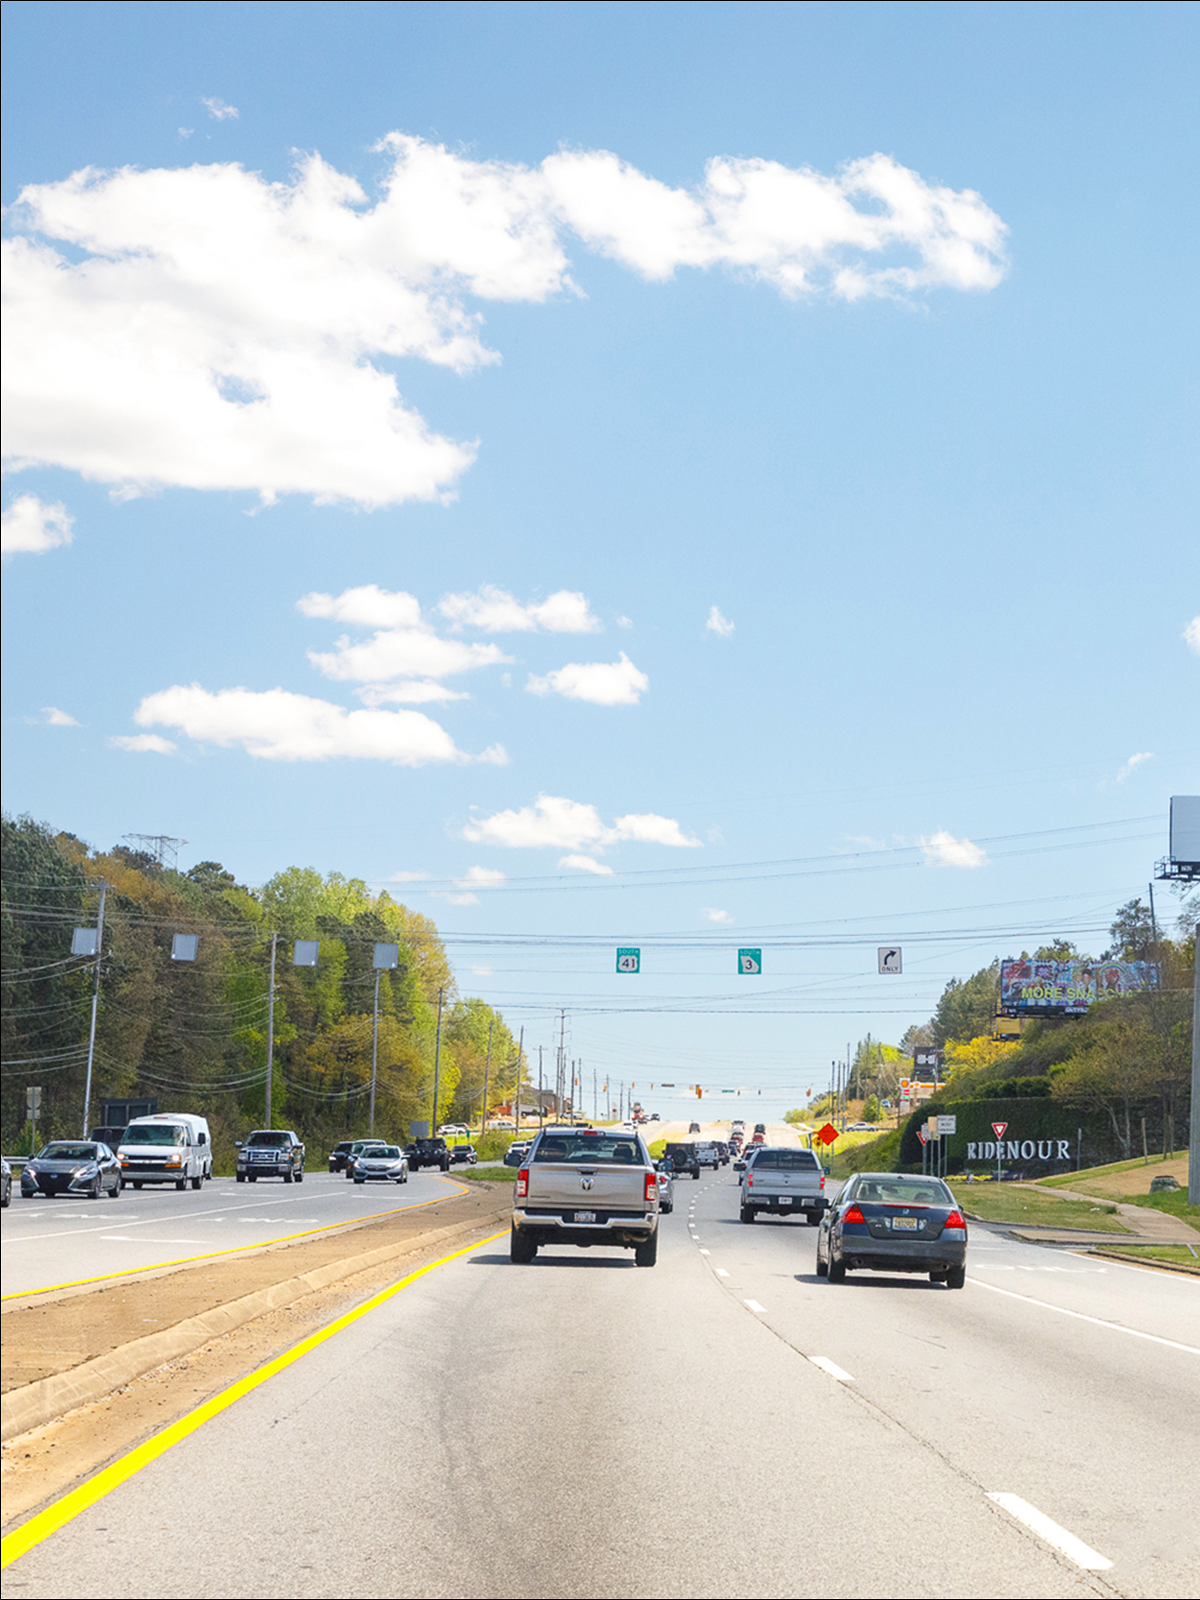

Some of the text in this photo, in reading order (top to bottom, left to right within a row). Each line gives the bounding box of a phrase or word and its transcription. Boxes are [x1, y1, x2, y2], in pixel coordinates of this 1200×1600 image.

[622, 958, 636, 969] 41
[745, 959, 753, 970] 3
[1021, 987, 1062, 999] MORE
[967, 1140, 1070, 1160] RIDENOUR
